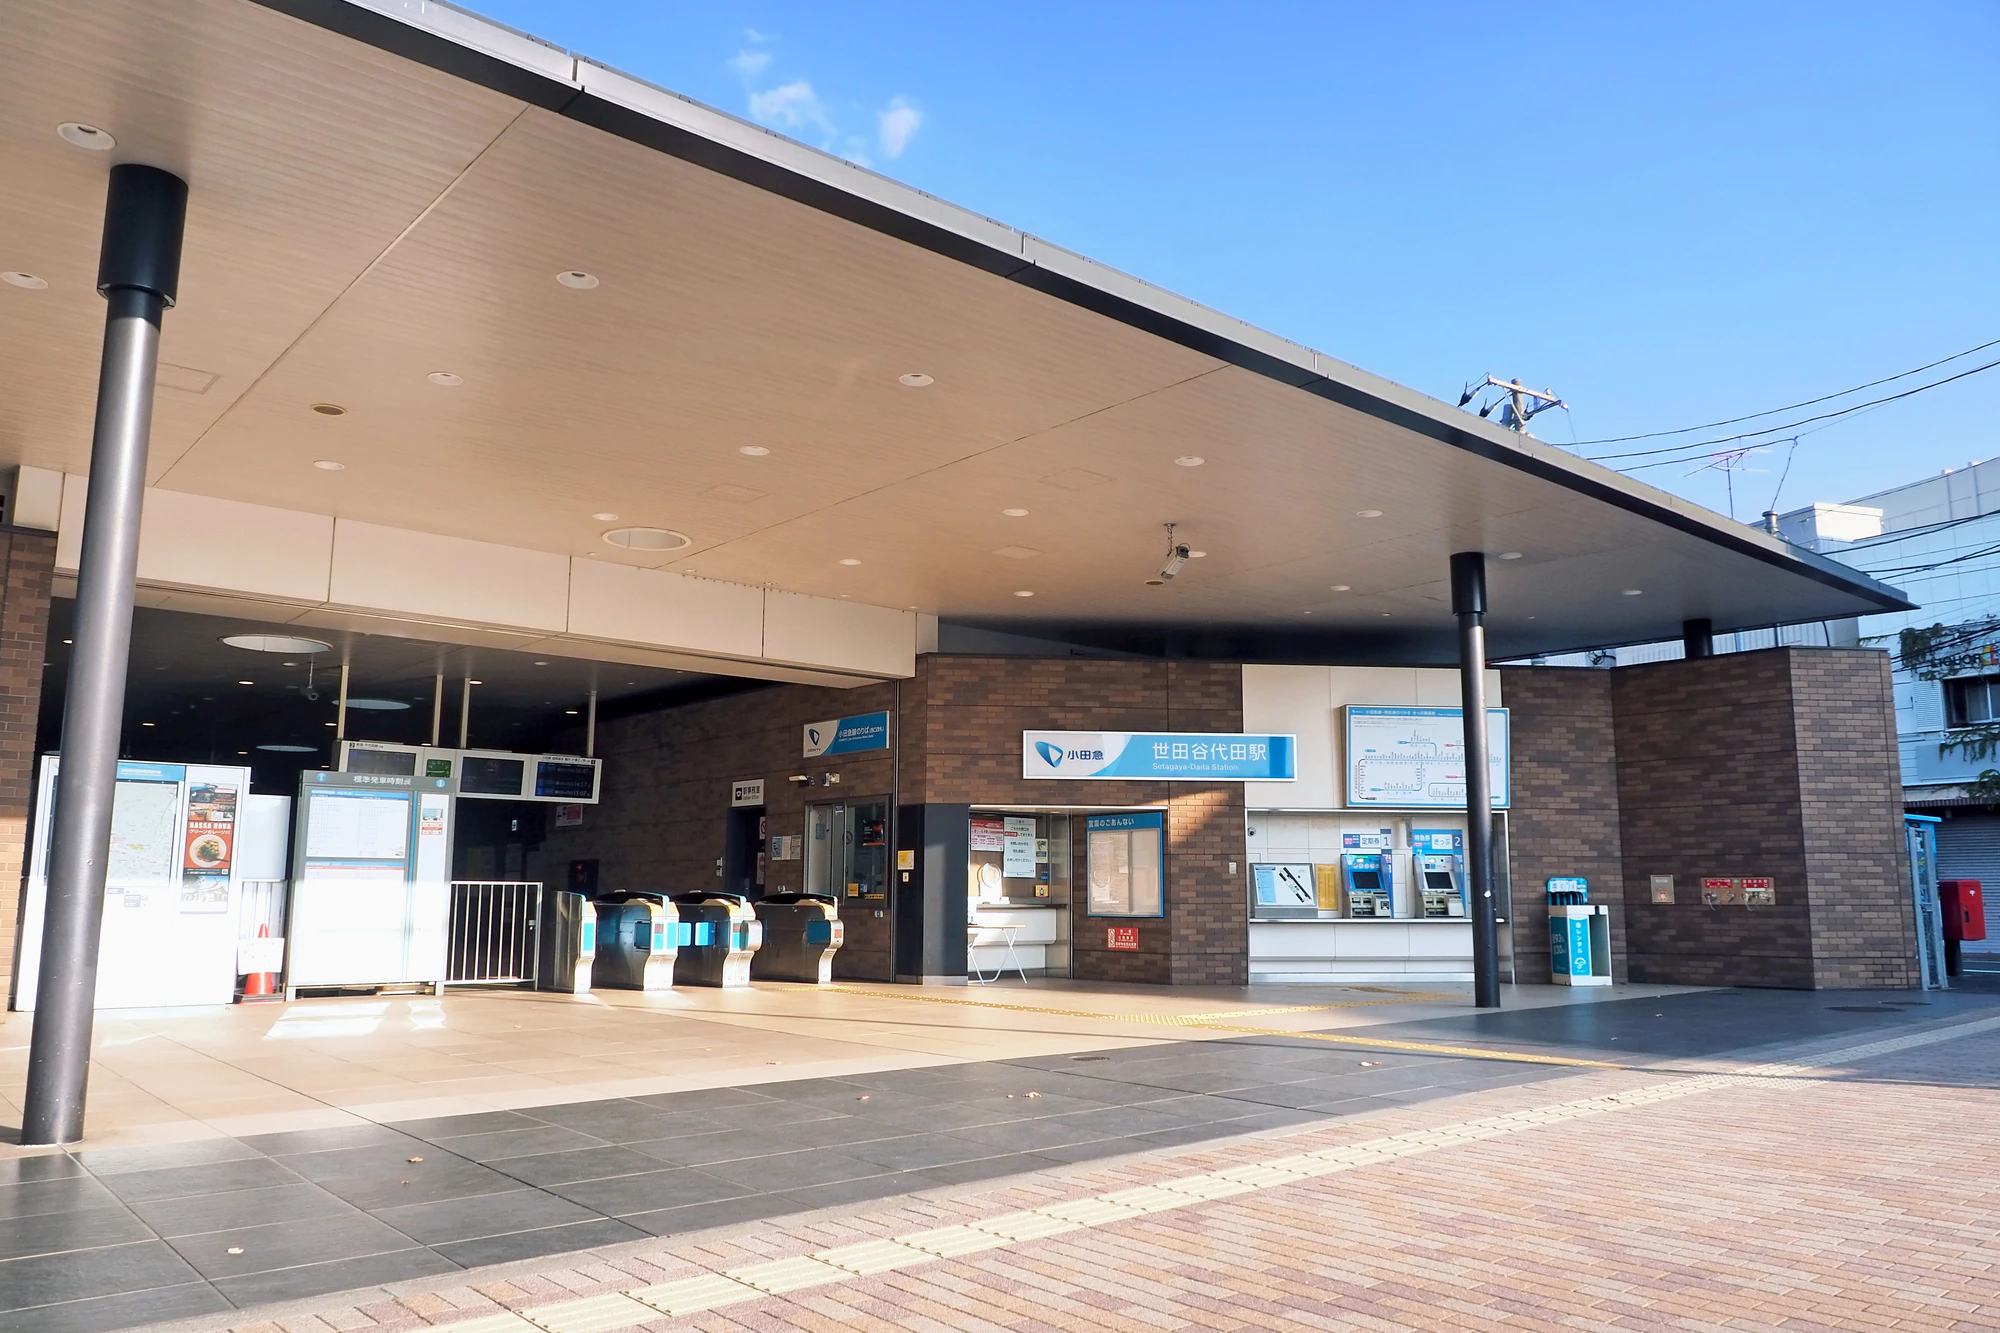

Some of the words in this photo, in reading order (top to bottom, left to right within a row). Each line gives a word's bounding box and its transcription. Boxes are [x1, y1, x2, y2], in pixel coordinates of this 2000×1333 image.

[1067, 749, 1104, 761] 小田急
[1152, 742, 1267, 761] 世田谷代田駅
[1152, 762, 1210, 772] Setagaya-Daita
[353, 775, 412, 786] 標準発車時刻表
[1361, 837, 1380, 846] 定期券
[1384, 837, 1390, 847] 1
[1454, 836, 1461, 847] 2
